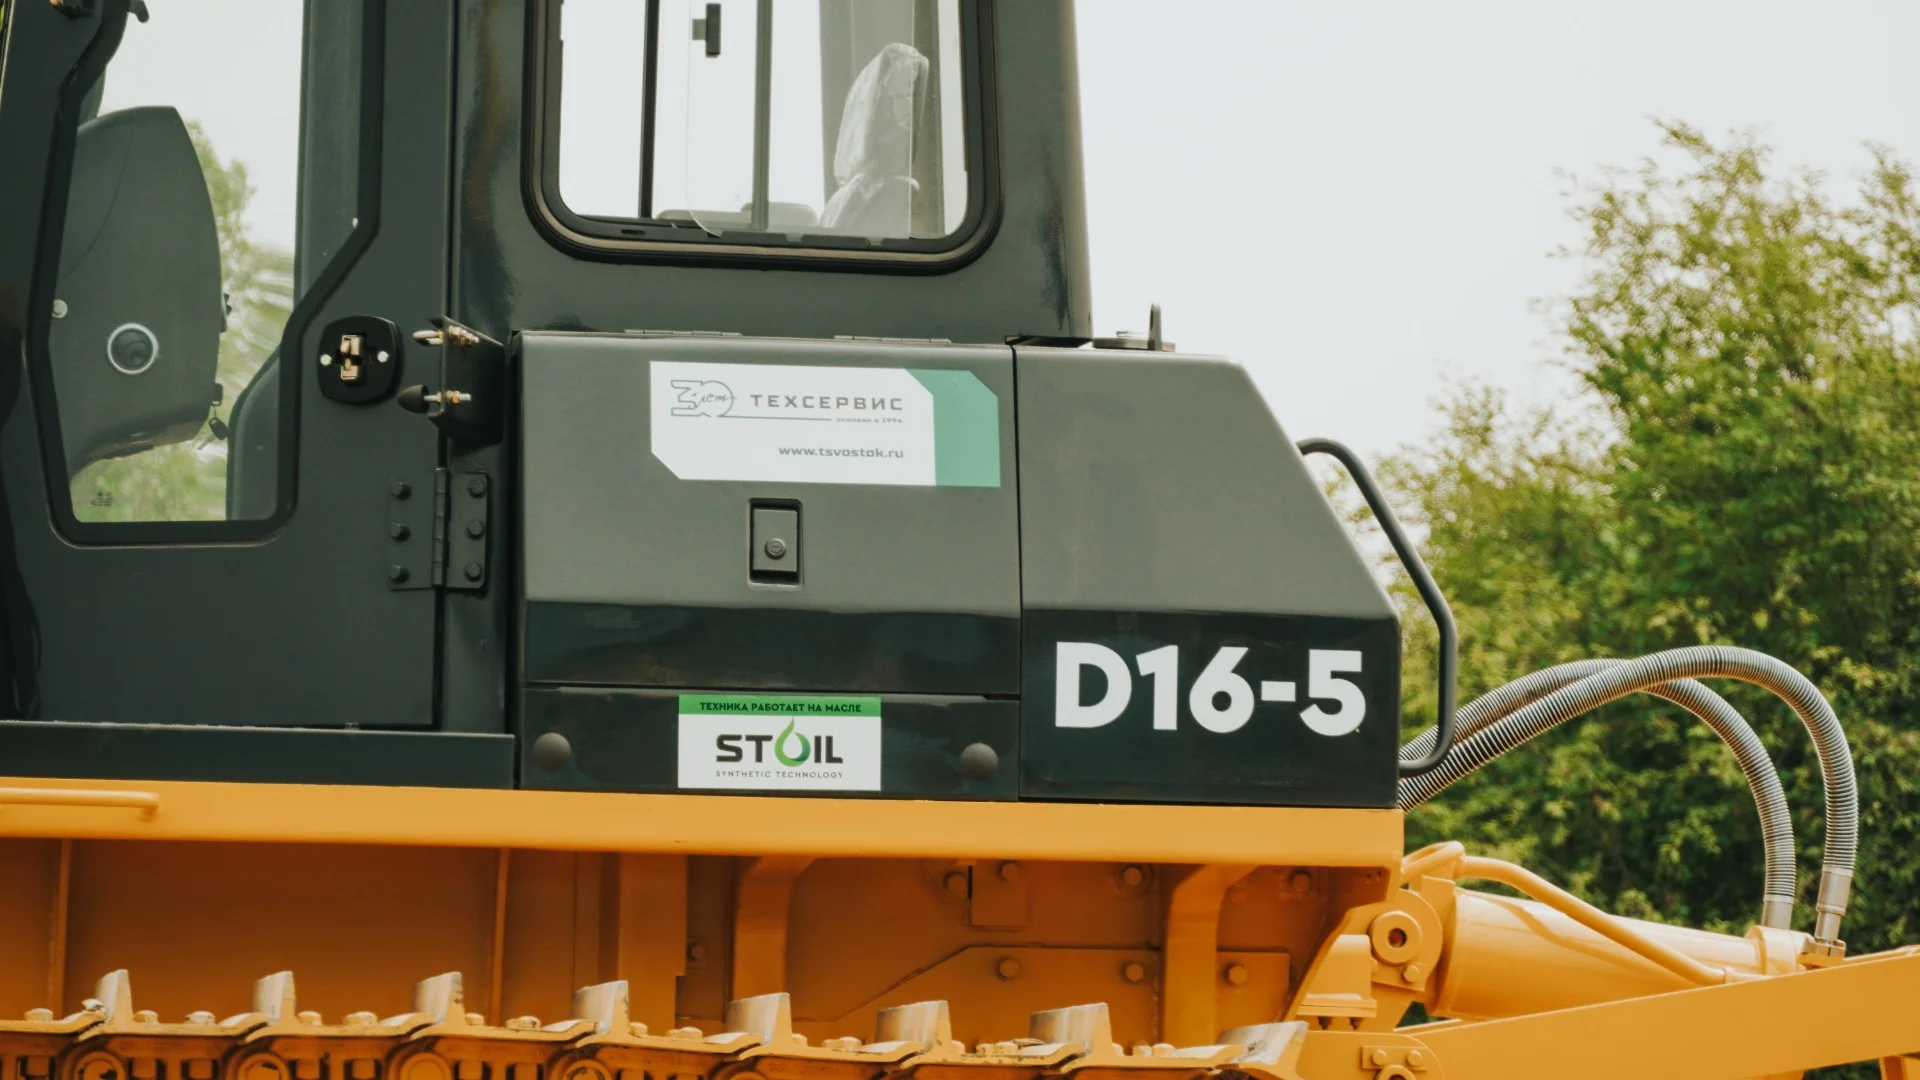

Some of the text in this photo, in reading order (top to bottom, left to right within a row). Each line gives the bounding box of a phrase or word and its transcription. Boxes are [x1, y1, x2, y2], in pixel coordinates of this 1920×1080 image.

[749, 394, 903, 411] ТЕХСЕРВИС
[778, 447, 904, 458] www.tsvostok.ru
[1055, 641, 1366, 737] D16-5
[700, 702, 862, 712] ТЕХНИКА РАБОТАЕТ НА МАСЛЕ
[716, 717, 843, 767] STOIL
[716, 770, 843, 779] SYNTHETIC TECHNOLOGY
